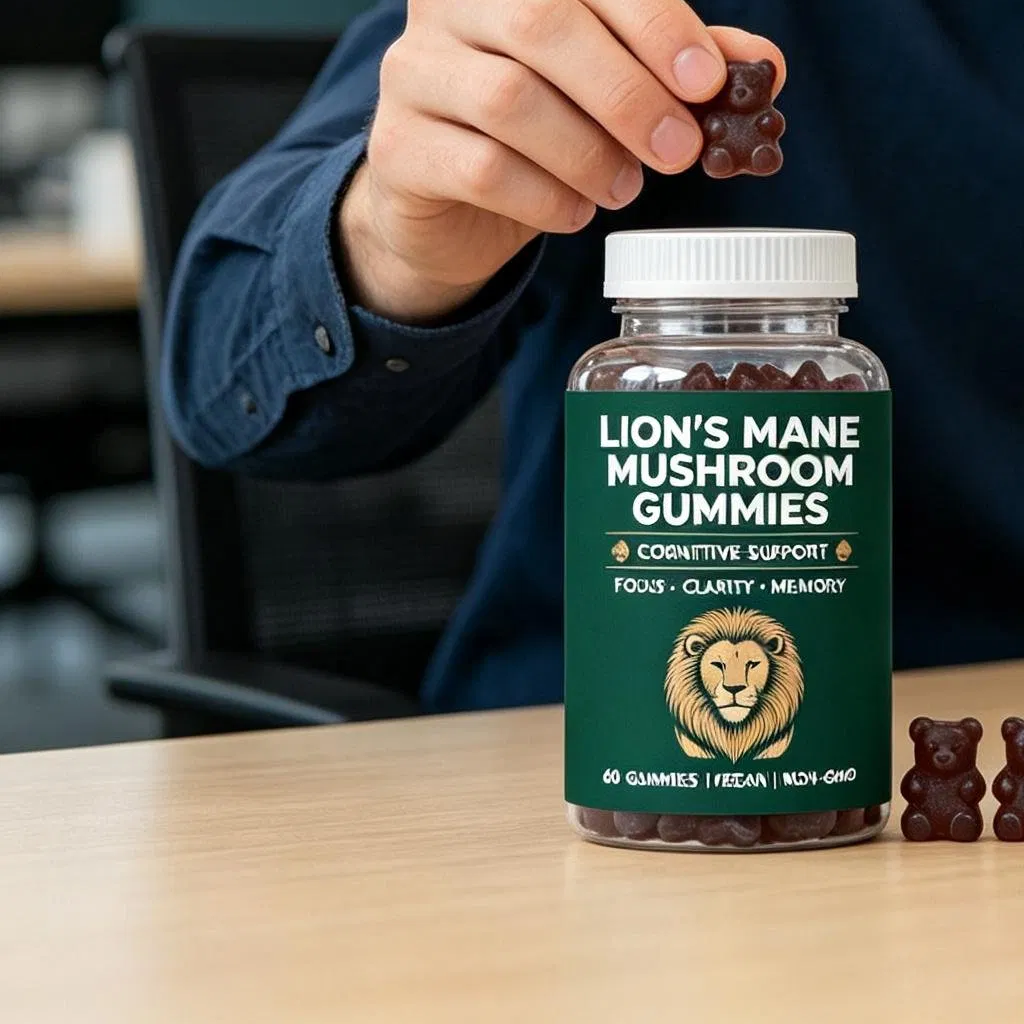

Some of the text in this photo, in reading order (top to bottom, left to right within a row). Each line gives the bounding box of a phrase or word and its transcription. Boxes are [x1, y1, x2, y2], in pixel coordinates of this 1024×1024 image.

[600, 414, 860, 450] LION'S MANE
[607, 452, 853, 488] MUSHROOM
[632, 491, 829, 526] GUMMIES
[771, 578, 847, 595] MEMORY
[602, 768, 621, 785] 60
